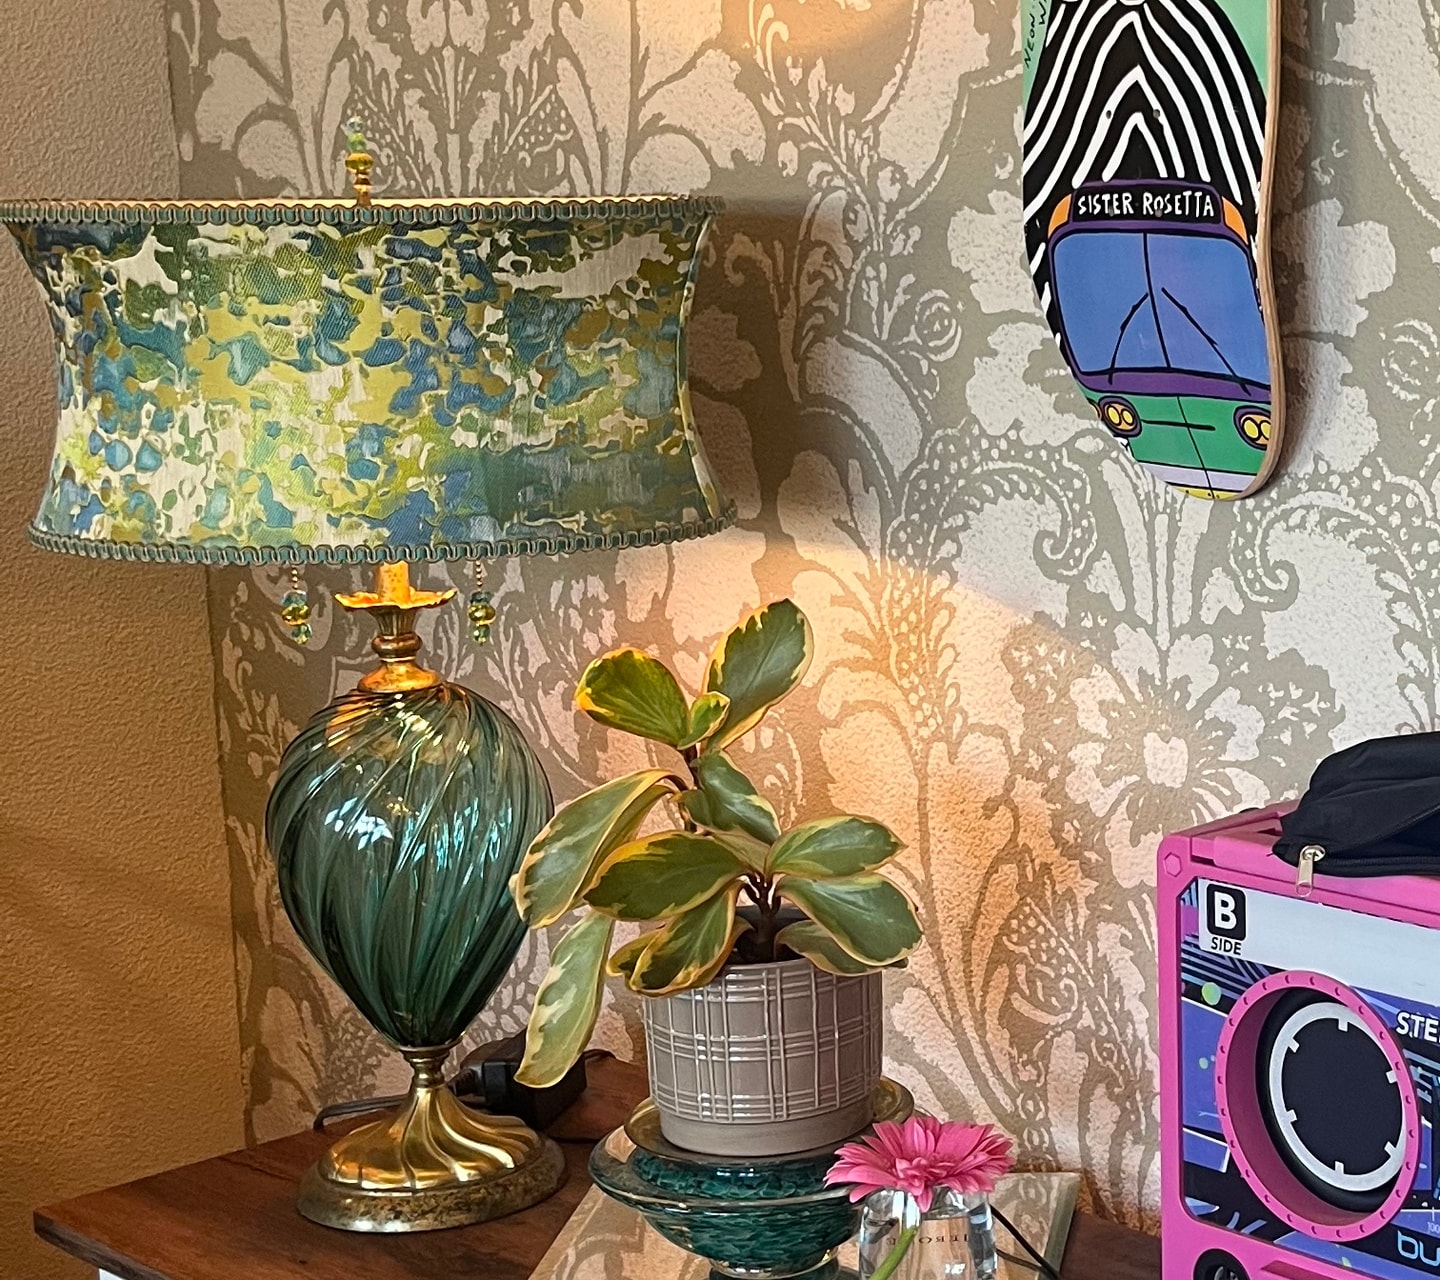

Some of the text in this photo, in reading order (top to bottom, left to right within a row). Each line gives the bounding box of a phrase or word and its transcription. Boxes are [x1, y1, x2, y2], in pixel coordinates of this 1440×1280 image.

[1077, 190, 1215, 218] SISTER ROSETTA
[1213, 892, 1238, 931] B
[1210, 937, 1242, 956] SIDE
[1427, 1222, 1440, 1234] 100
